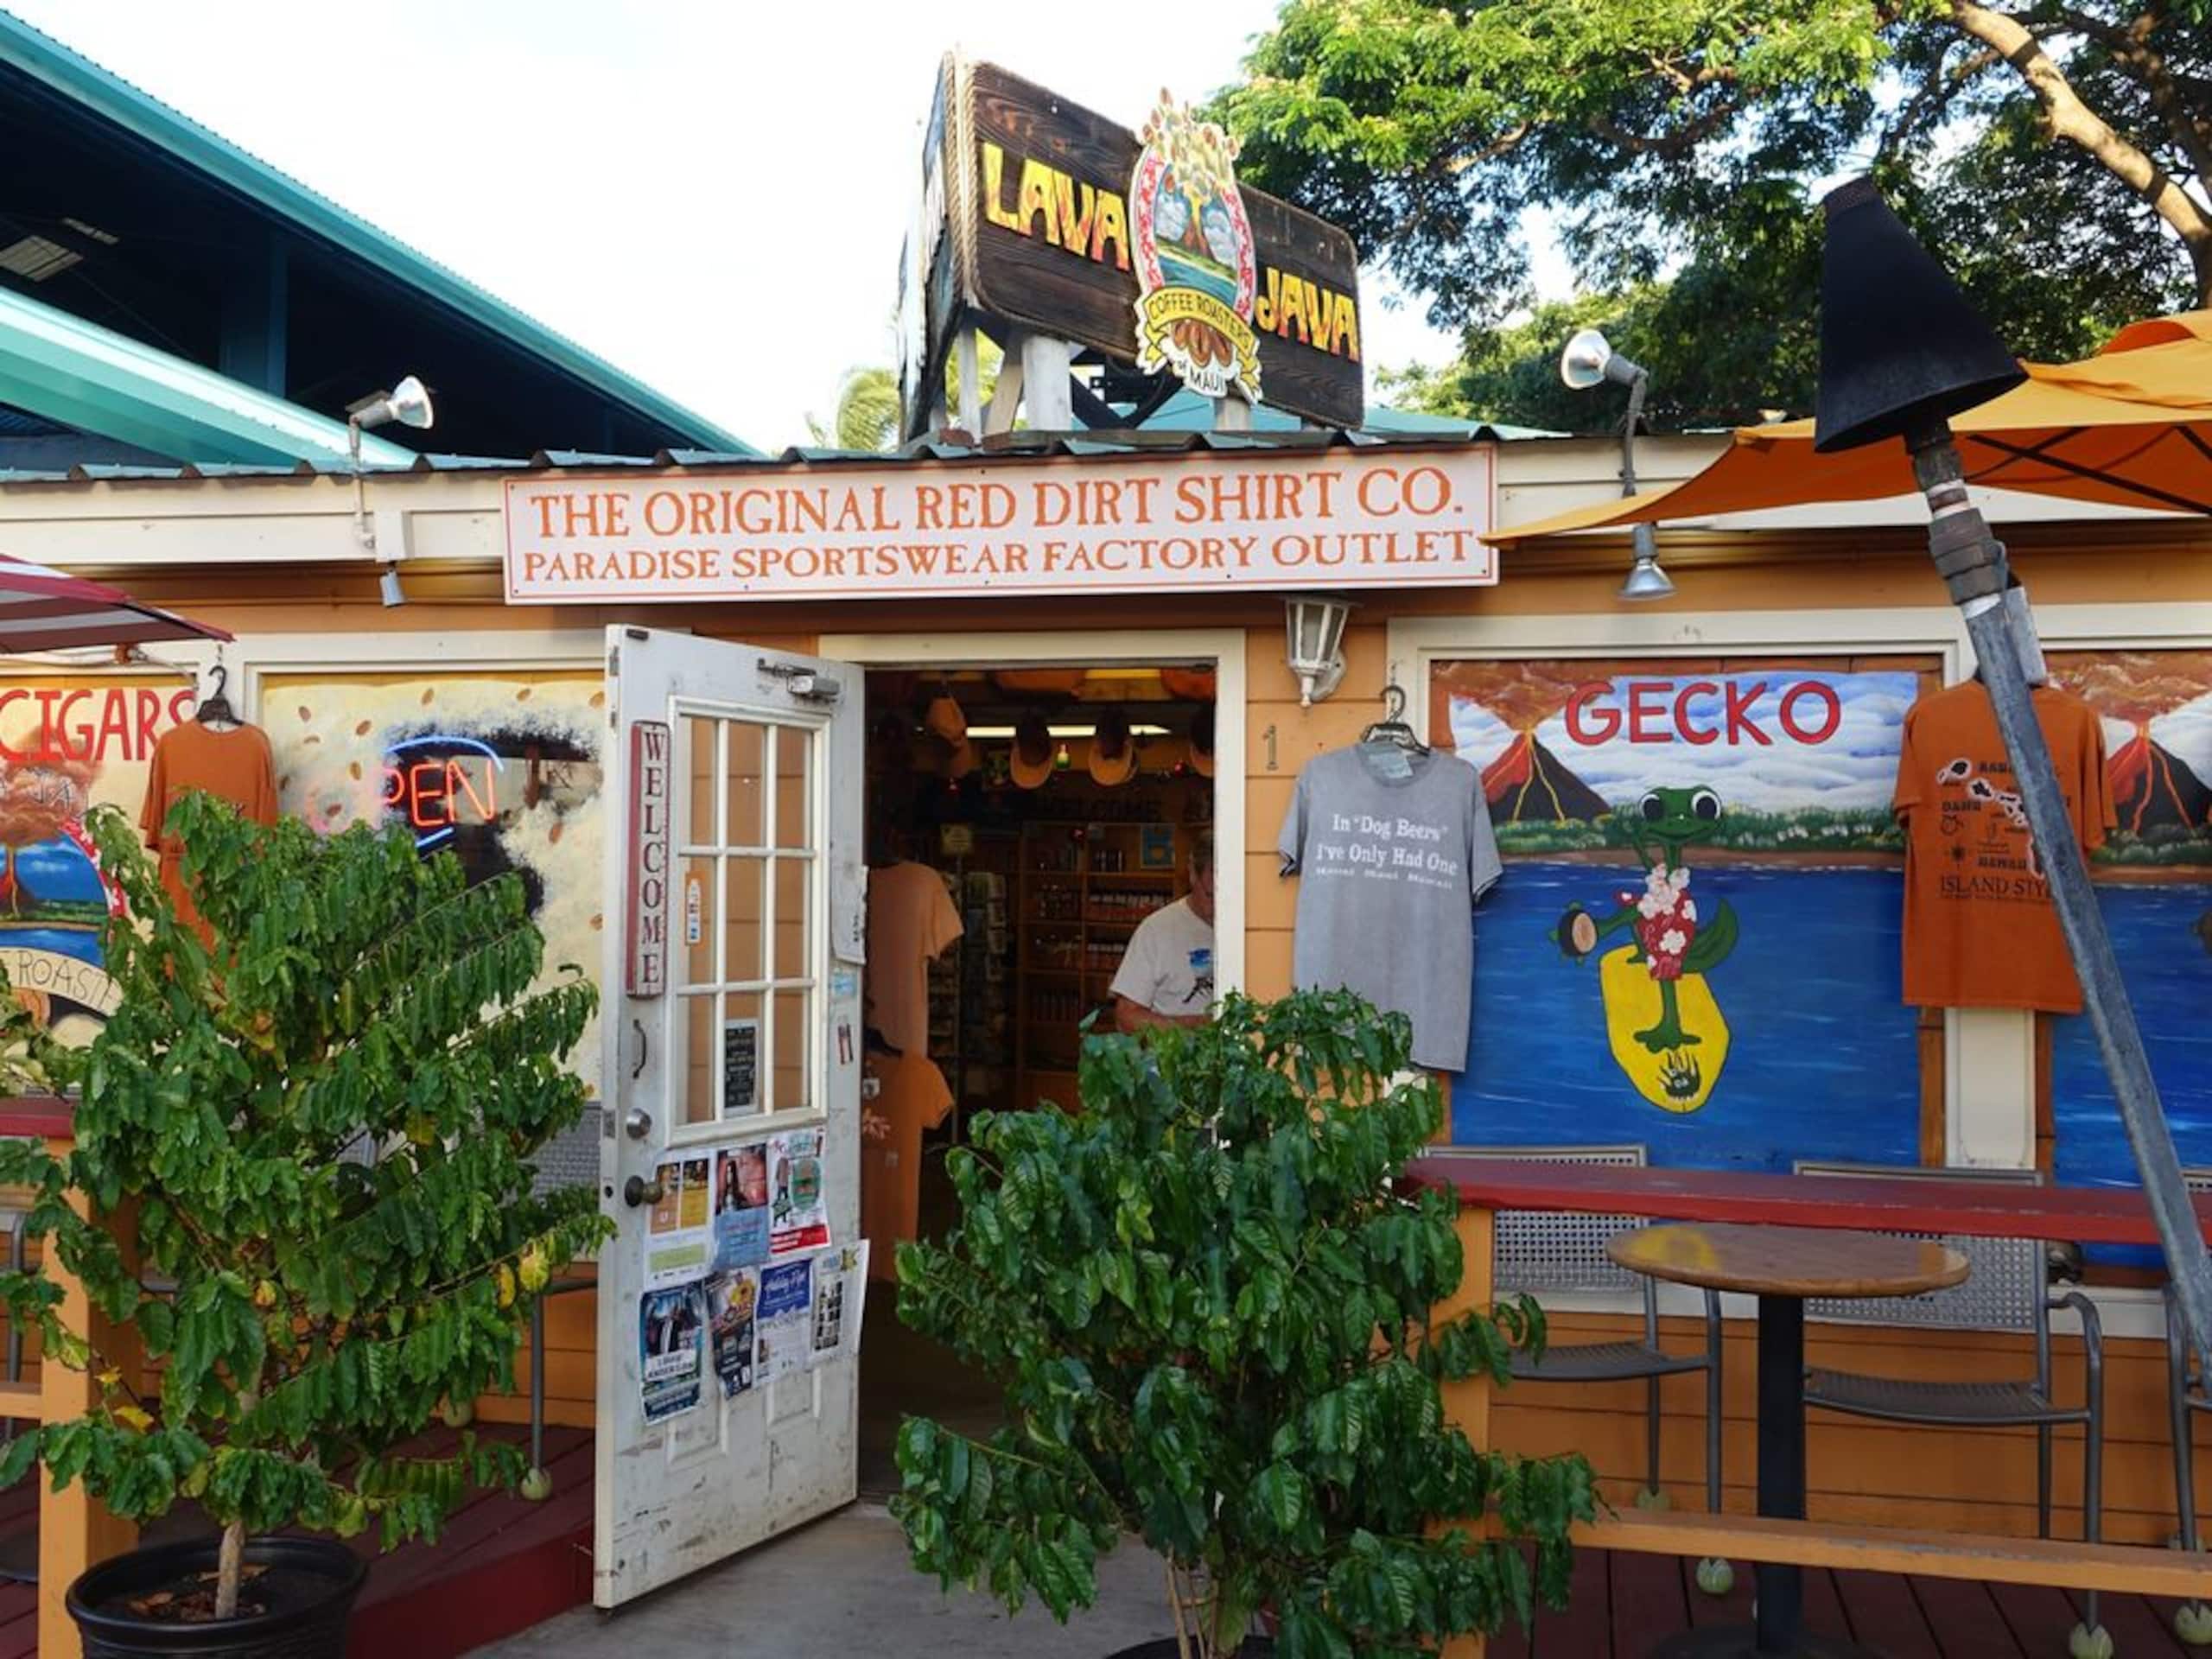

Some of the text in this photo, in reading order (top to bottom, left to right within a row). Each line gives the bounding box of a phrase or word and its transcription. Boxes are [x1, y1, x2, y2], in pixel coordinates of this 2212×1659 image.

[982, 142, 1359, 361] LAVA JAVA
[1149, 292, 1249, 350] COFFEE ROASTERS
[1190, 366, 1225, 391] MAUI
[531, 466, 1464, 537] THE ORIGINAL RED DIRT SHIRT CO.
[524, 530, 1473, 582] PARADISE SPORTSWEAR FACTORY OUTLET
[1565, 680, 1841, 747] GECKO
[307, 758, 495, 830] PEN
[1332, 814, 1351, 831] In
[641, 731, 664, 984] WELCOME
[1316, 843, 1459, 876] I've Only Had One
[2011, 877, 2052, 898] STY
